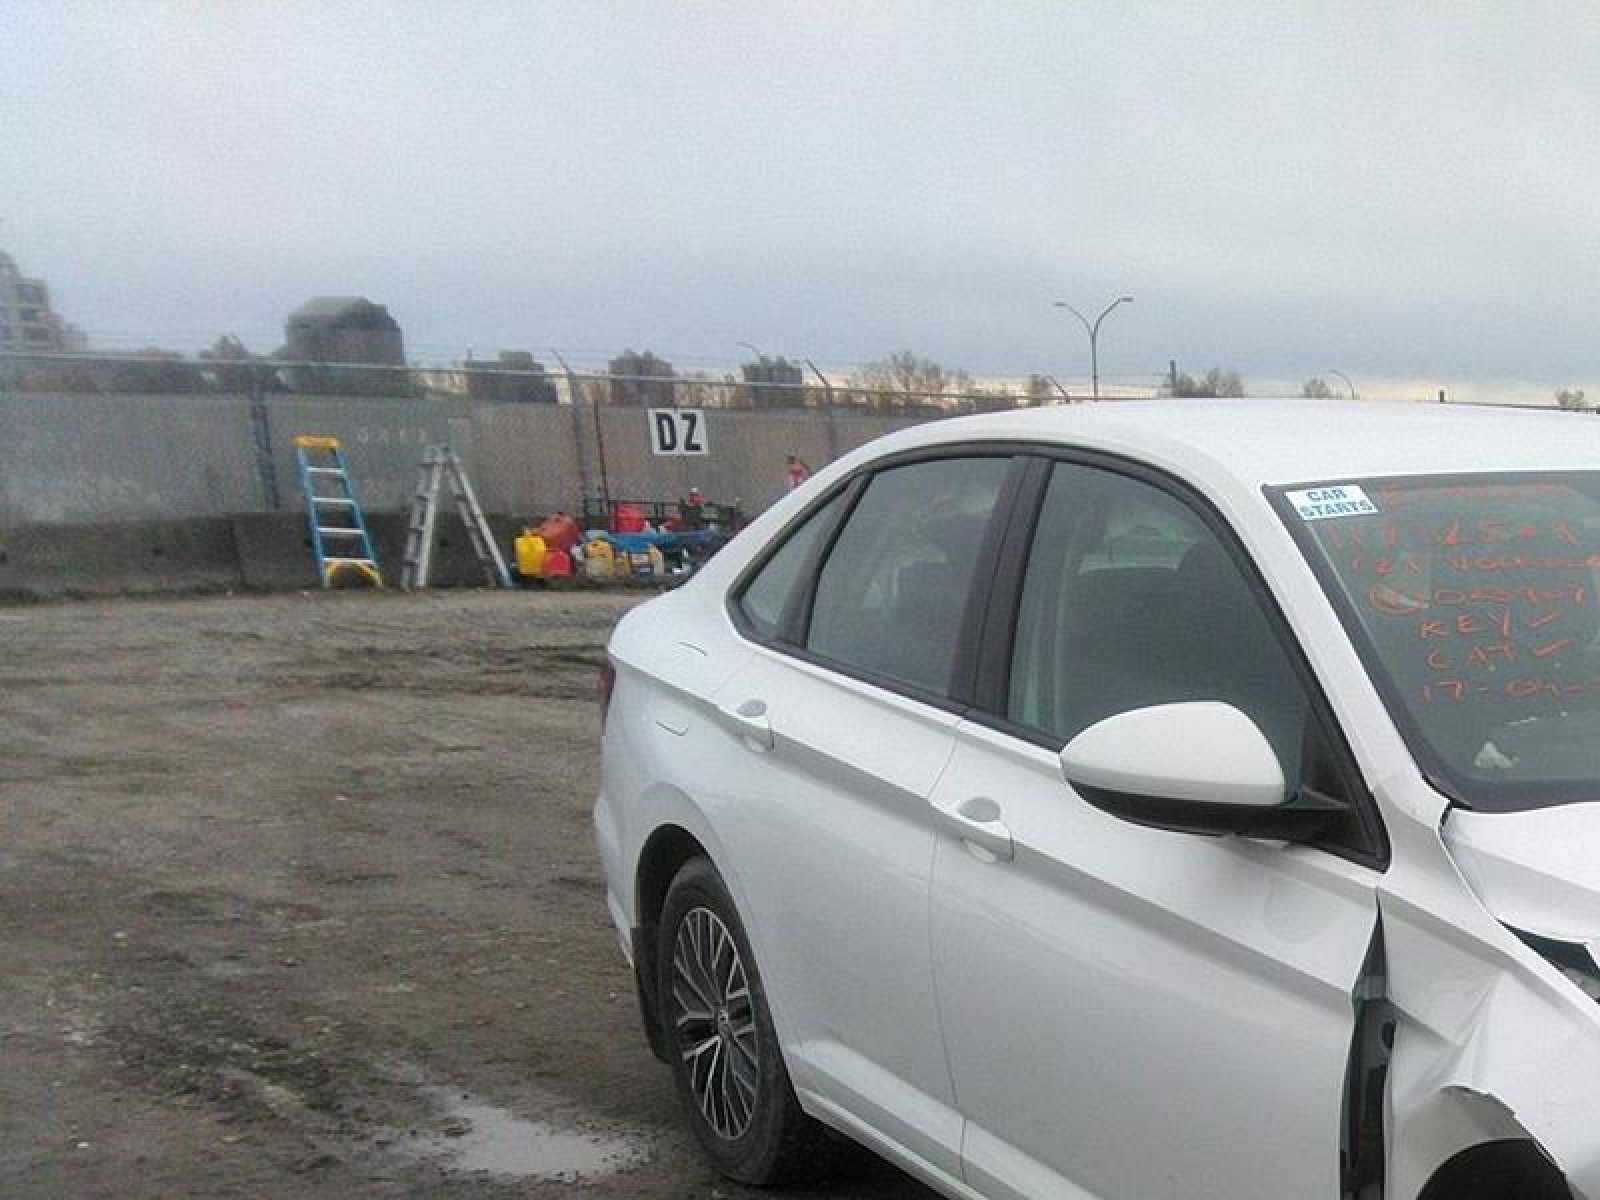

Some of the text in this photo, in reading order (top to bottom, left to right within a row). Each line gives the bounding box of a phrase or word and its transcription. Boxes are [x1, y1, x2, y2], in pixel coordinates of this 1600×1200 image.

[655, 412, 702, 451] DZ
[1306, 488, 1348, 501] CAR
[1300, 501, 1373, 517] STARTS
